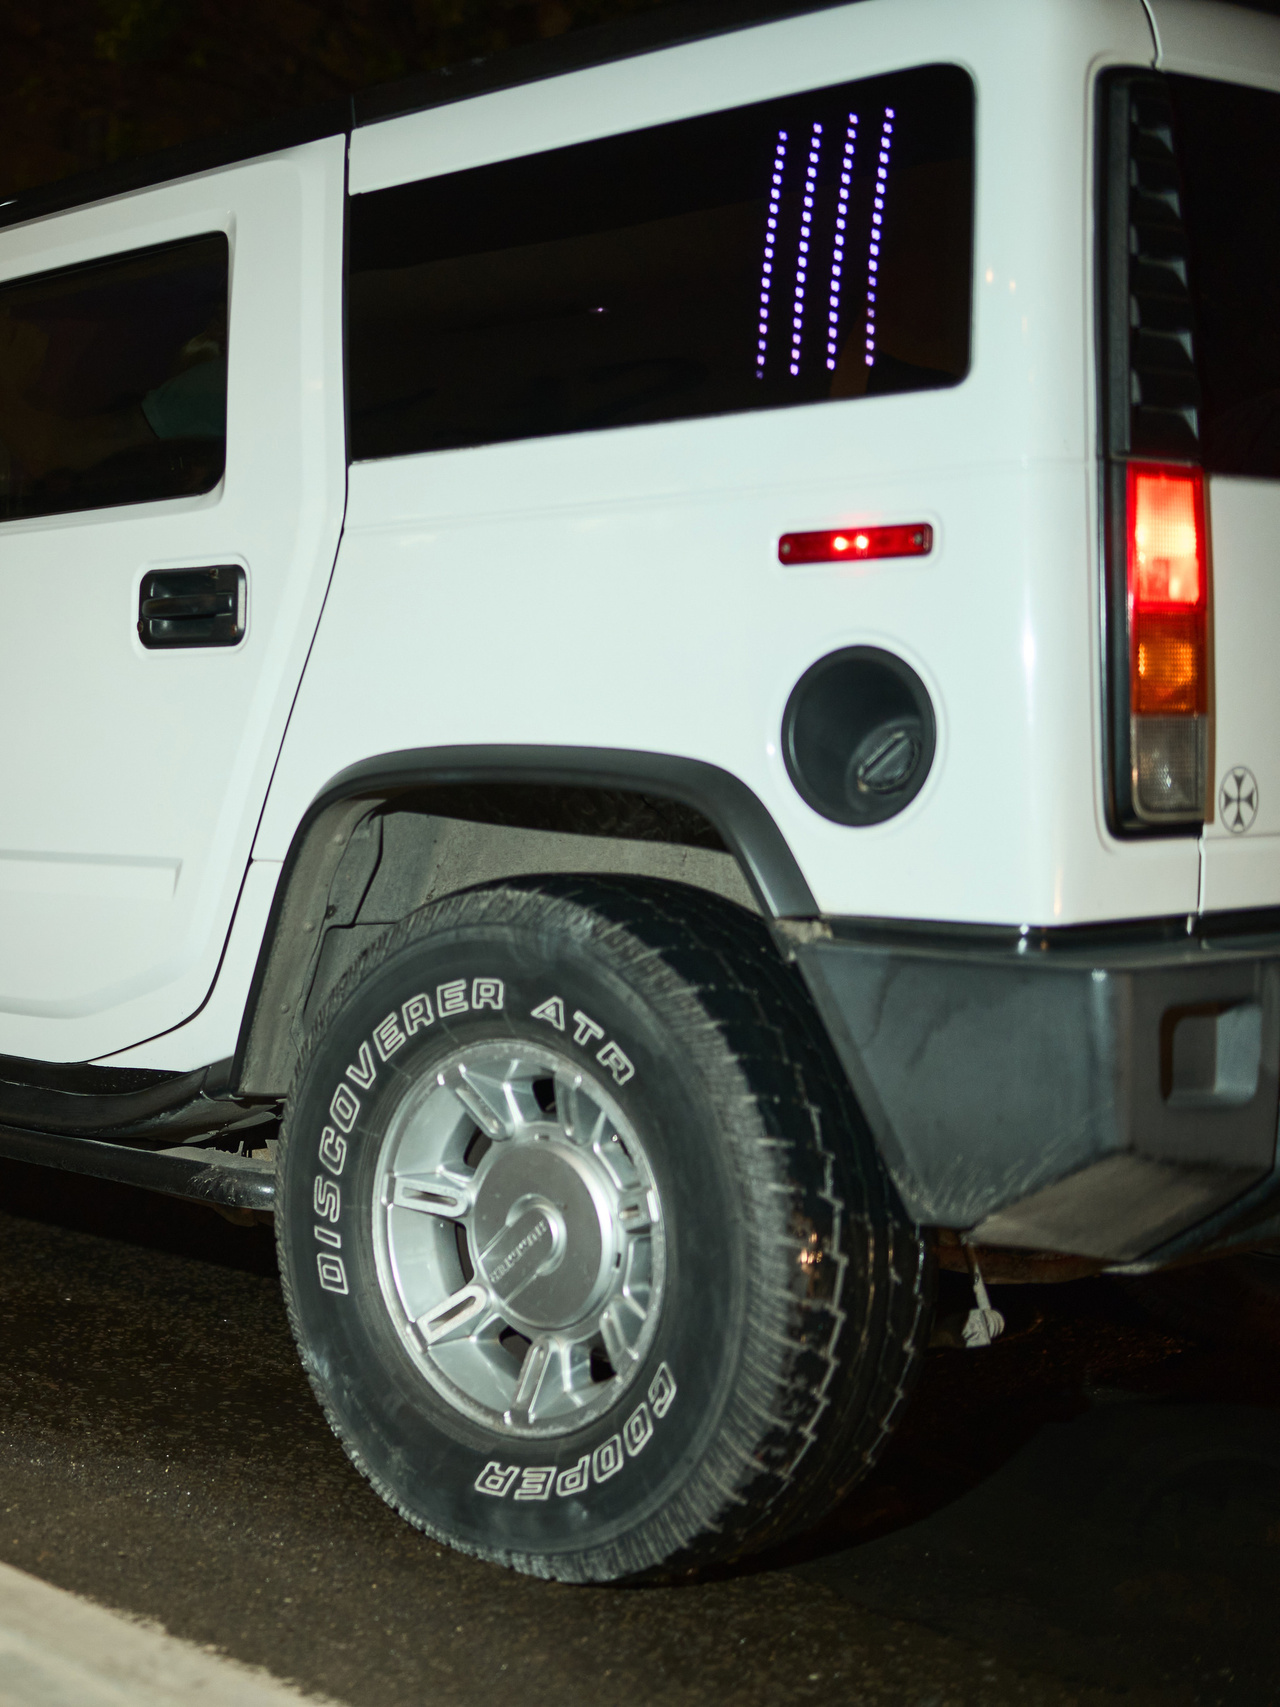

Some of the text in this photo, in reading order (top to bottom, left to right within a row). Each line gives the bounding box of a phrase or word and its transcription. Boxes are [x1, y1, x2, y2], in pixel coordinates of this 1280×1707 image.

[313, 977, 635, 1295] DISCOVERER ATR
[473, 1360, 678, 1501] COOPER
